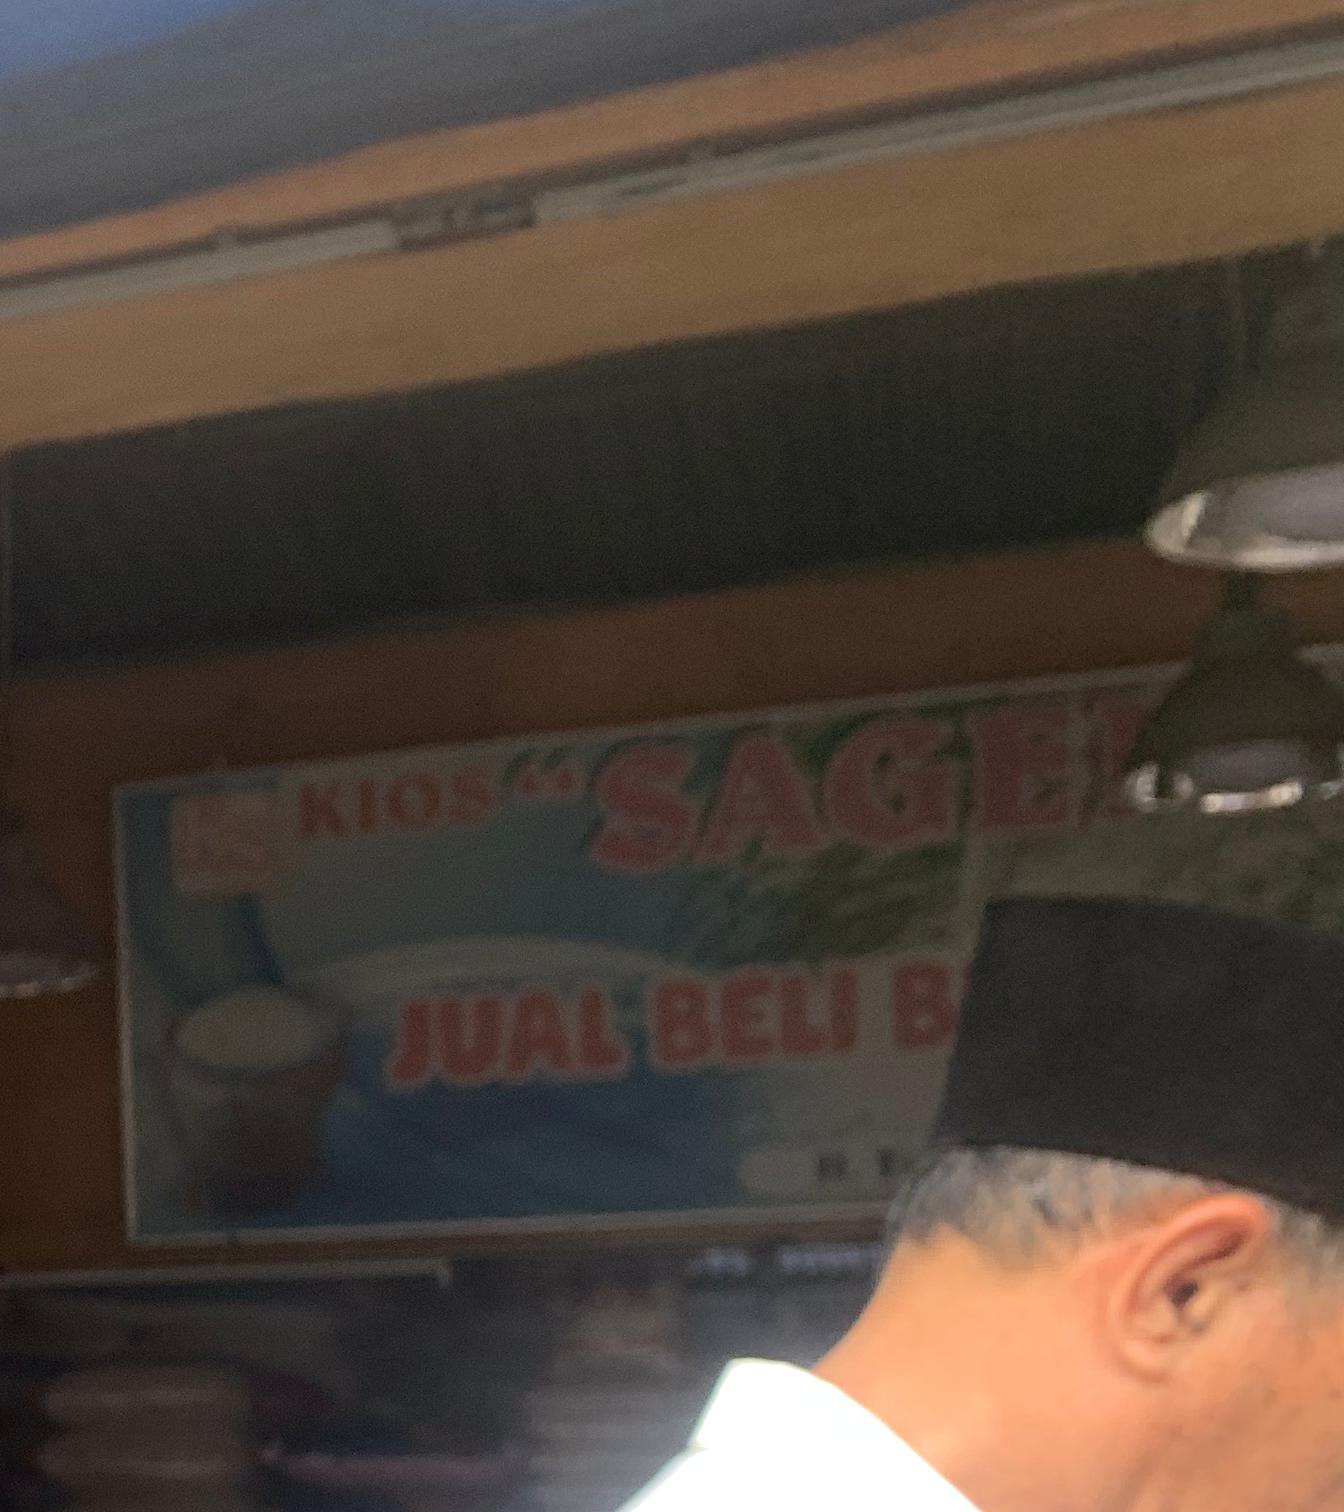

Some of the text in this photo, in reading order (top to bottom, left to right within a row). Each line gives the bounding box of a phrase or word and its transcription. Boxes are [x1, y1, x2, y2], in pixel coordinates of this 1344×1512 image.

[297, 767, 499, 841] KIOS
[388, 986, 627, 1094] JUAL
[648, 963, 859, 1069] BELI
